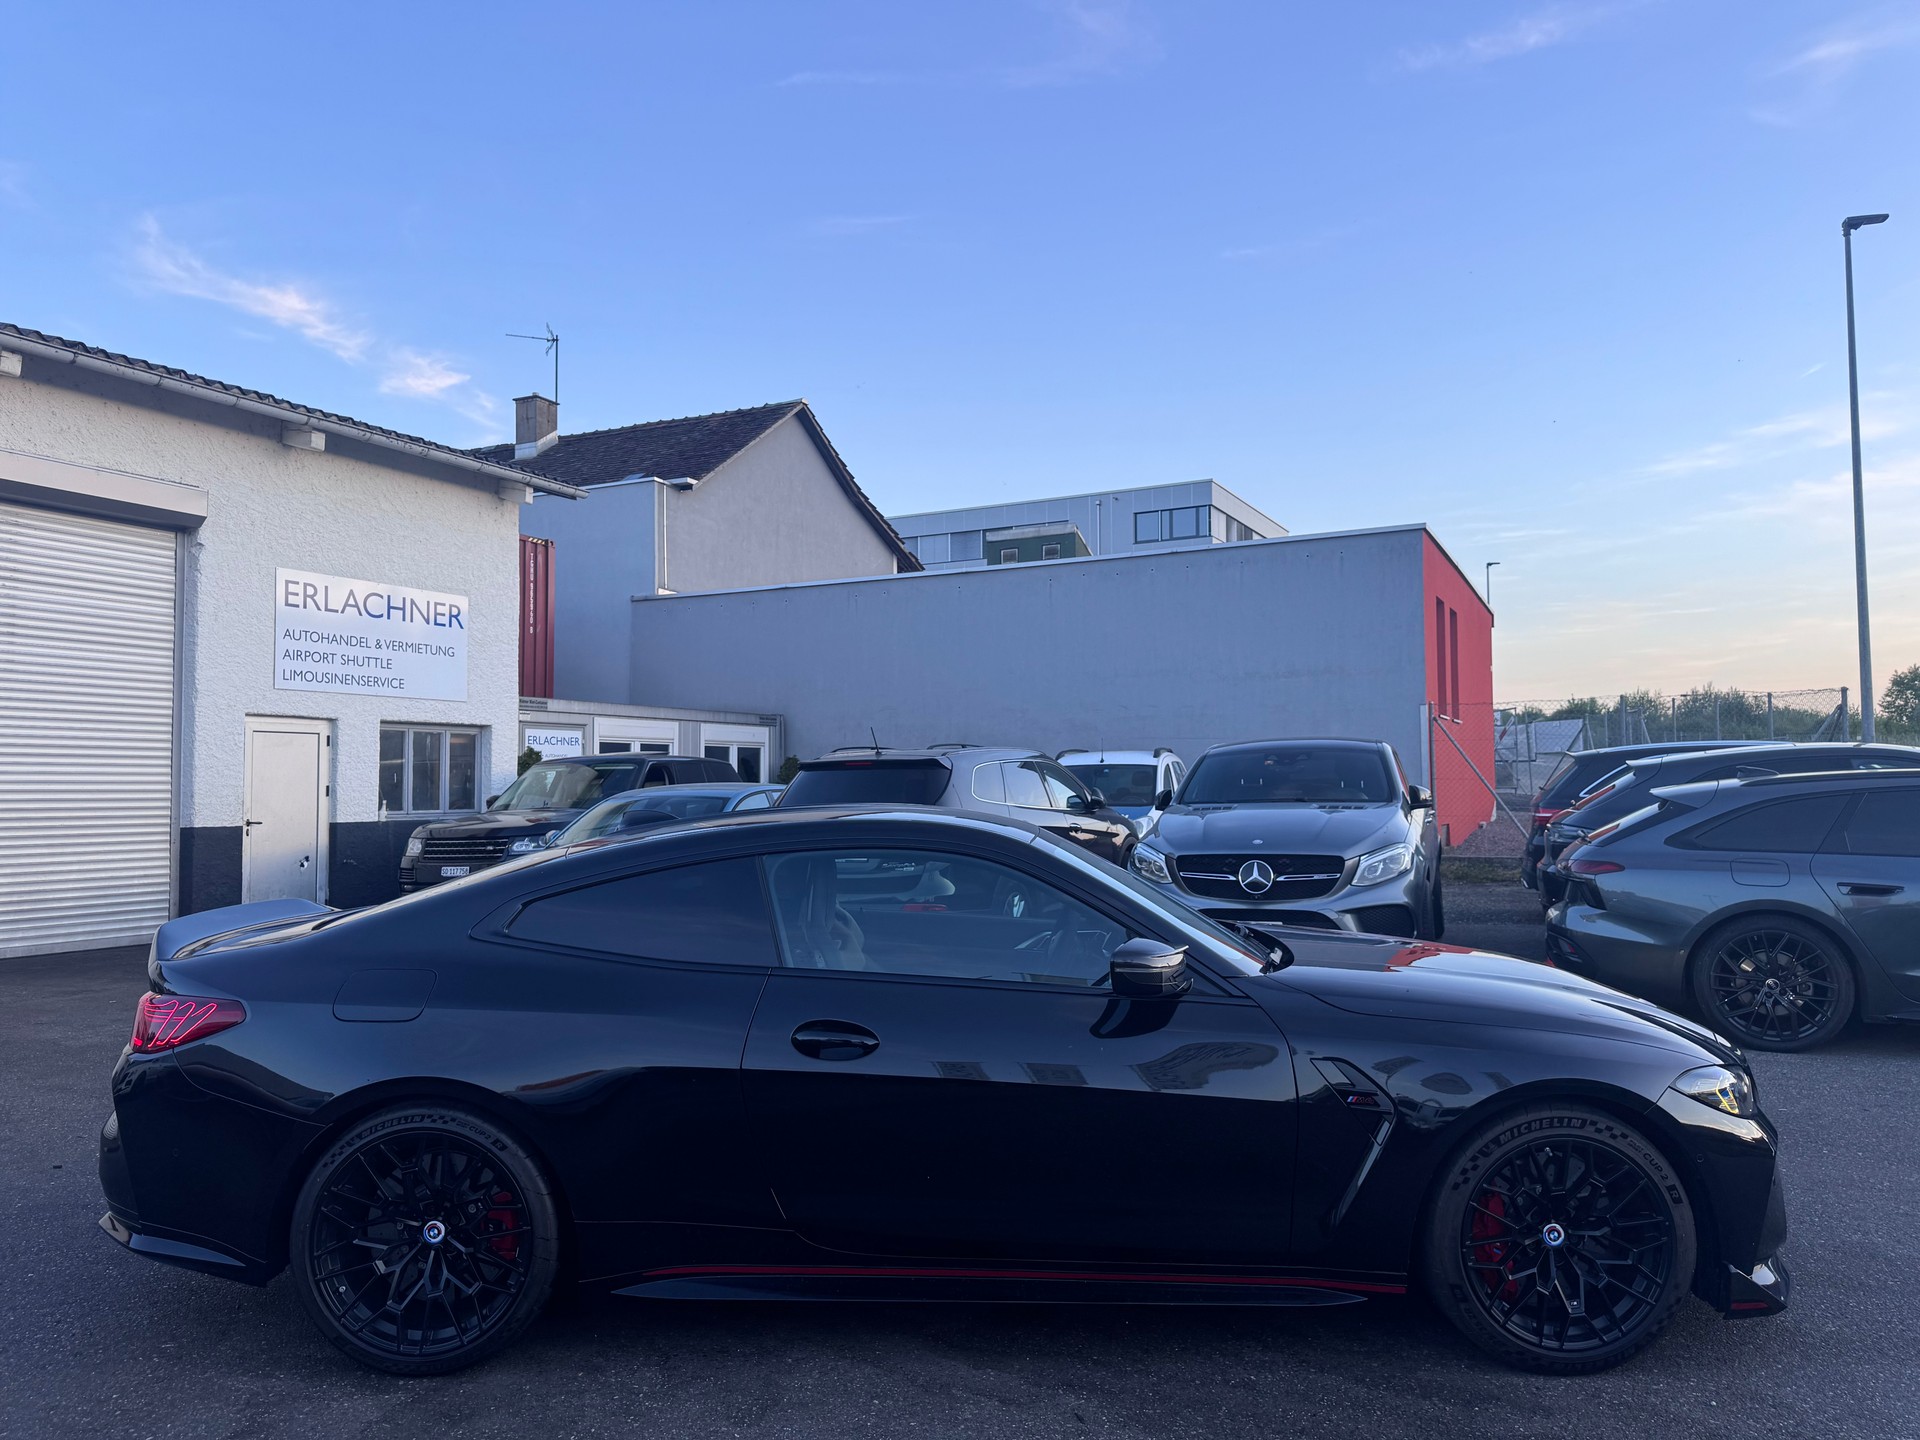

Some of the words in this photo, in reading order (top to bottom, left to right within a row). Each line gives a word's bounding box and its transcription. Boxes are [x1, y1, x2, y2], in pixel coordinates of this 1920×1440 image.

[284, 579, 464, 629] ERLACHNER
[282, 628, 371, 649] AUTOHANDEL
[374, 639, 383, 650] &
[384, 639, 455, 657] VERMIETUNG
[282, 649, 337, 665] AIRPORT
[340, 654, 393, 670] SHUTTLE
[282, 669, 405, 690] LIMOUSINENSERVICE
[527, 735, 580, 746] ERLACHNER
[361, 1115, 422, 1138] MICHELIN
[469, 1125, 487, 1136] CUP
[1499, 1118, 1583, 1144] MICHELIN
[1643, 1153, 1664, 1172] CUP
